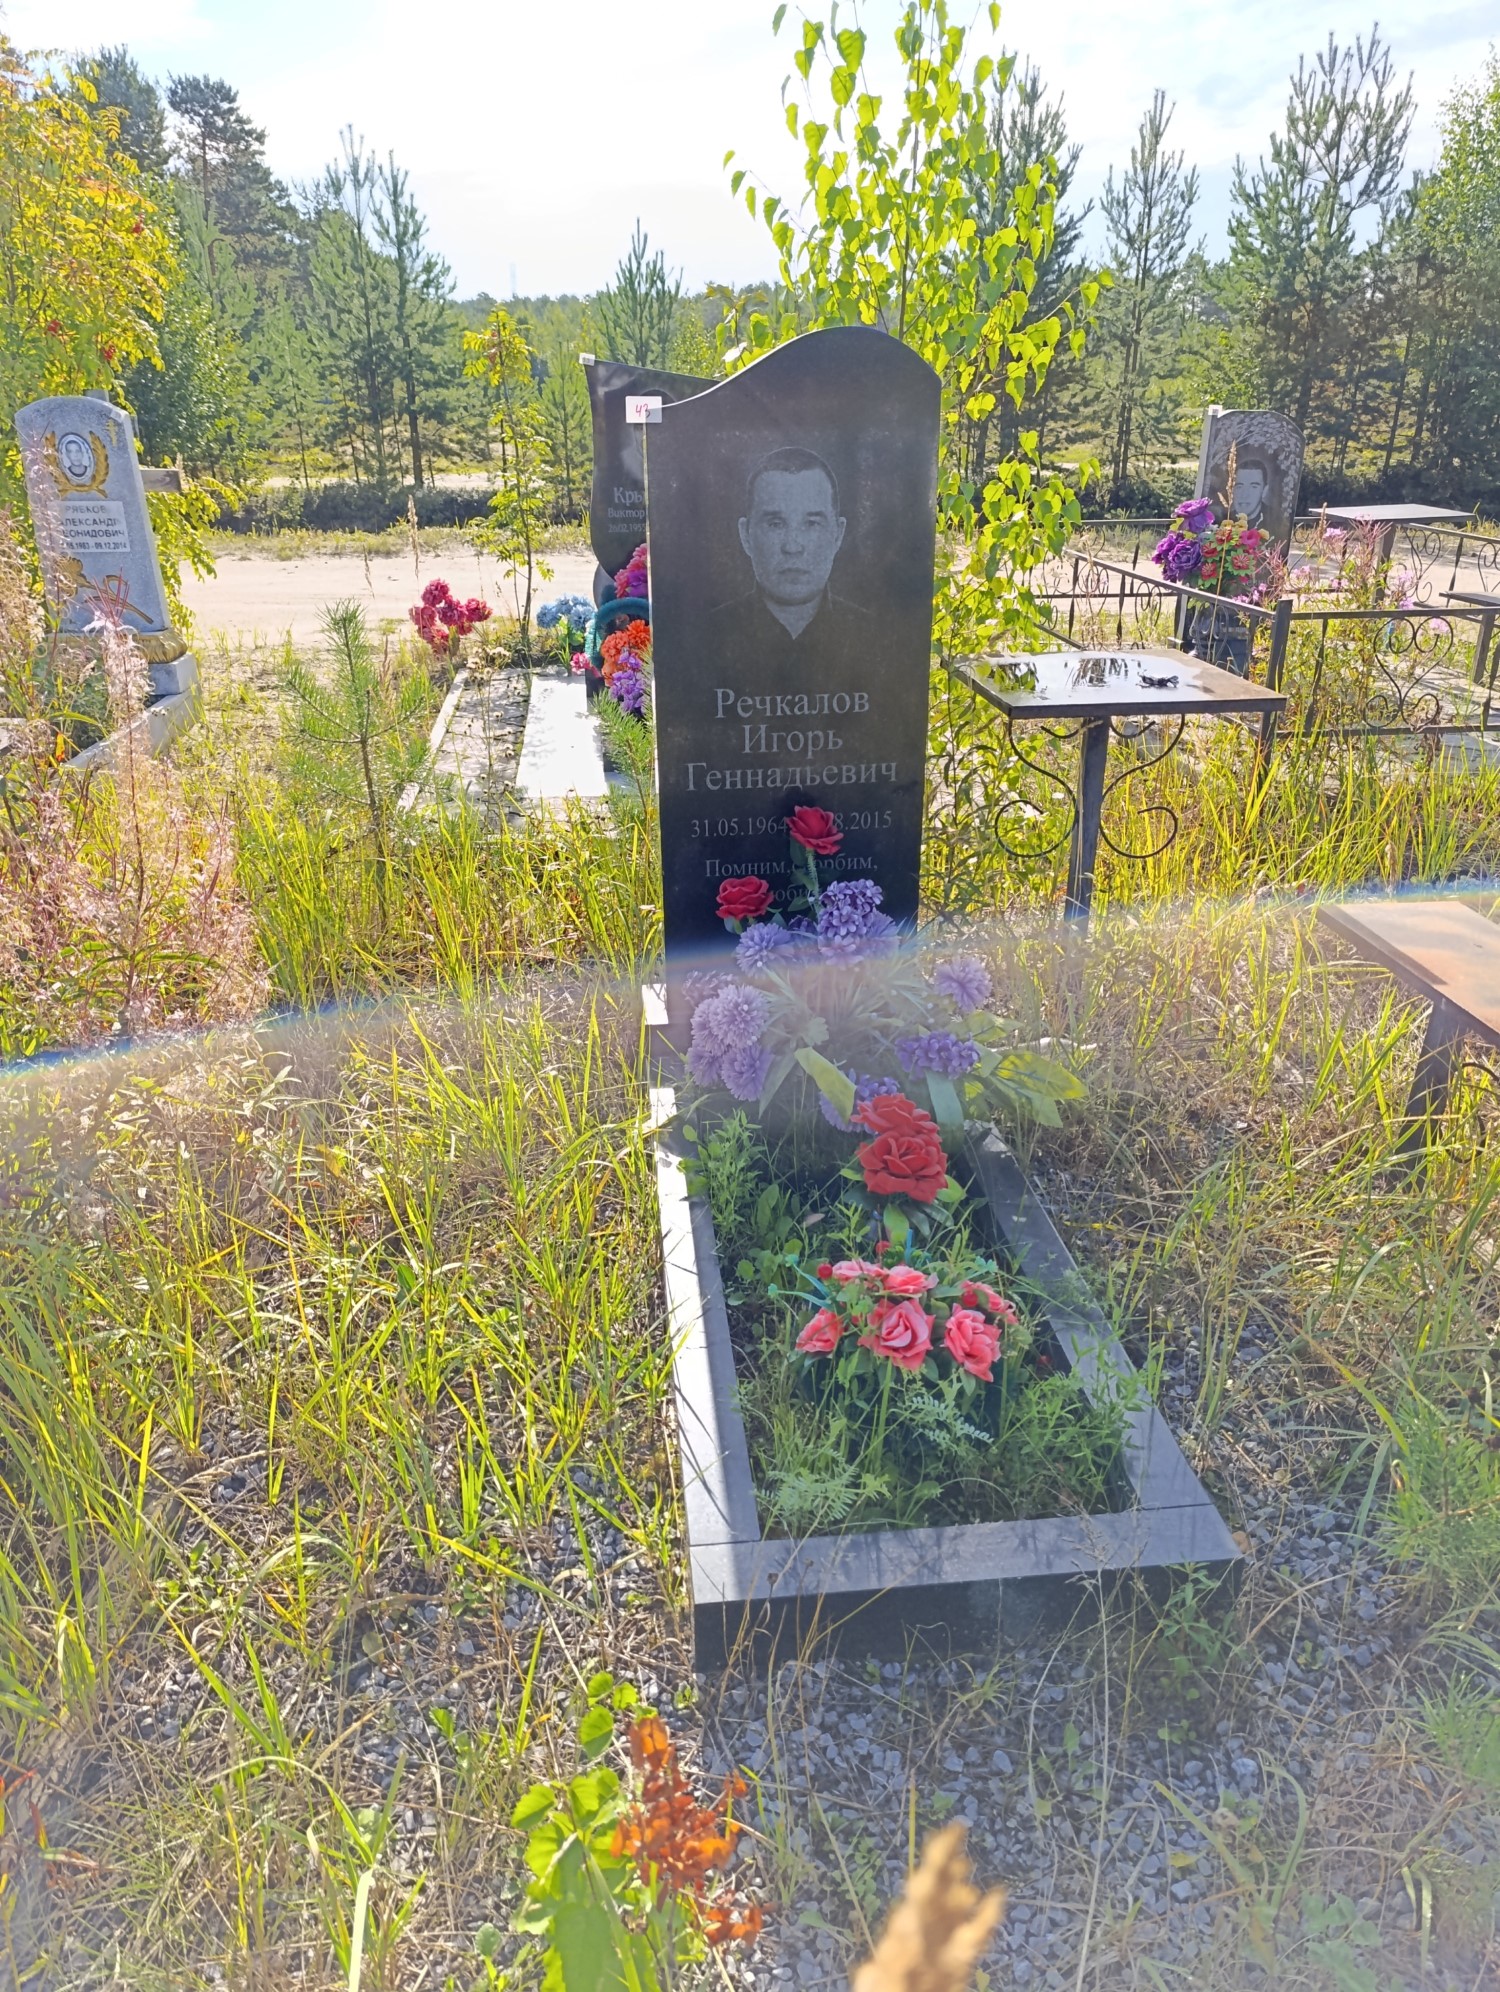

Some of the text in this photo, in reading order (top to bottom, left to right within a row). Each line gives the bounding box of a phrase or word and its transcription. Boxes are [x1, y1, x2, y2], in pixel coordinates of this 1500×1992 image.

[635, 403, 651, 418] 43
[713, 687, 870, 719] Речкалов
[741, 723, 844, 760] Игорь
[685, 761, 898, 792] Геннадьевич
[690, 817, 788, 838] 31.05.1964
[704, 858, 790, 877] Помним,
